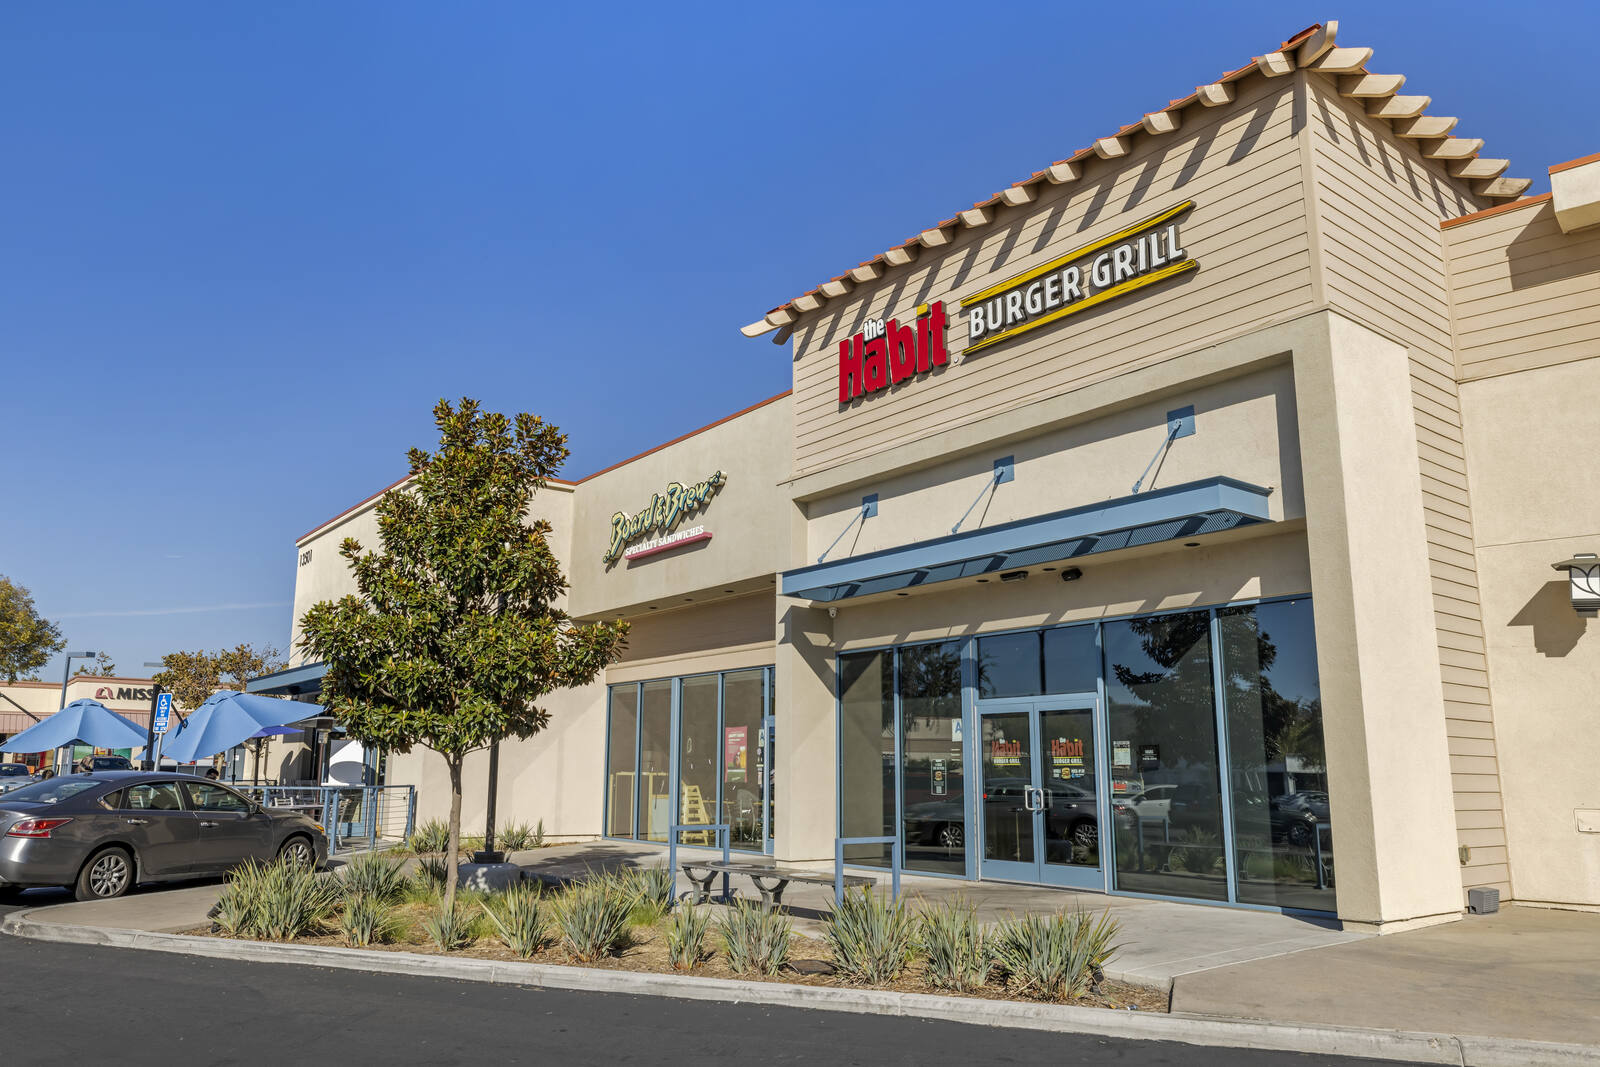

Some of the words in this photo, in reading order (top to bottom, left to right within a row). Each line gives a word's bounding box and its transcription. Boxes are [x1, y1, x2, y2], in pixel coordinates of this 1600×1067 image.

[969, 266, 1081, 338] BURGER
[1091, 225, 1182, 288] GRILL
[839, 300, 947, 403] Habit
[863, 318, 885, 342] the
[610, 493, 658, 559] Board
[665, 481, 711, 529] Brew
[625, 541, 658, 556] SPECIALTY
[658, 525, 704, 546] SANDWICHES
[1051, 740, 1083, 756] Habit
